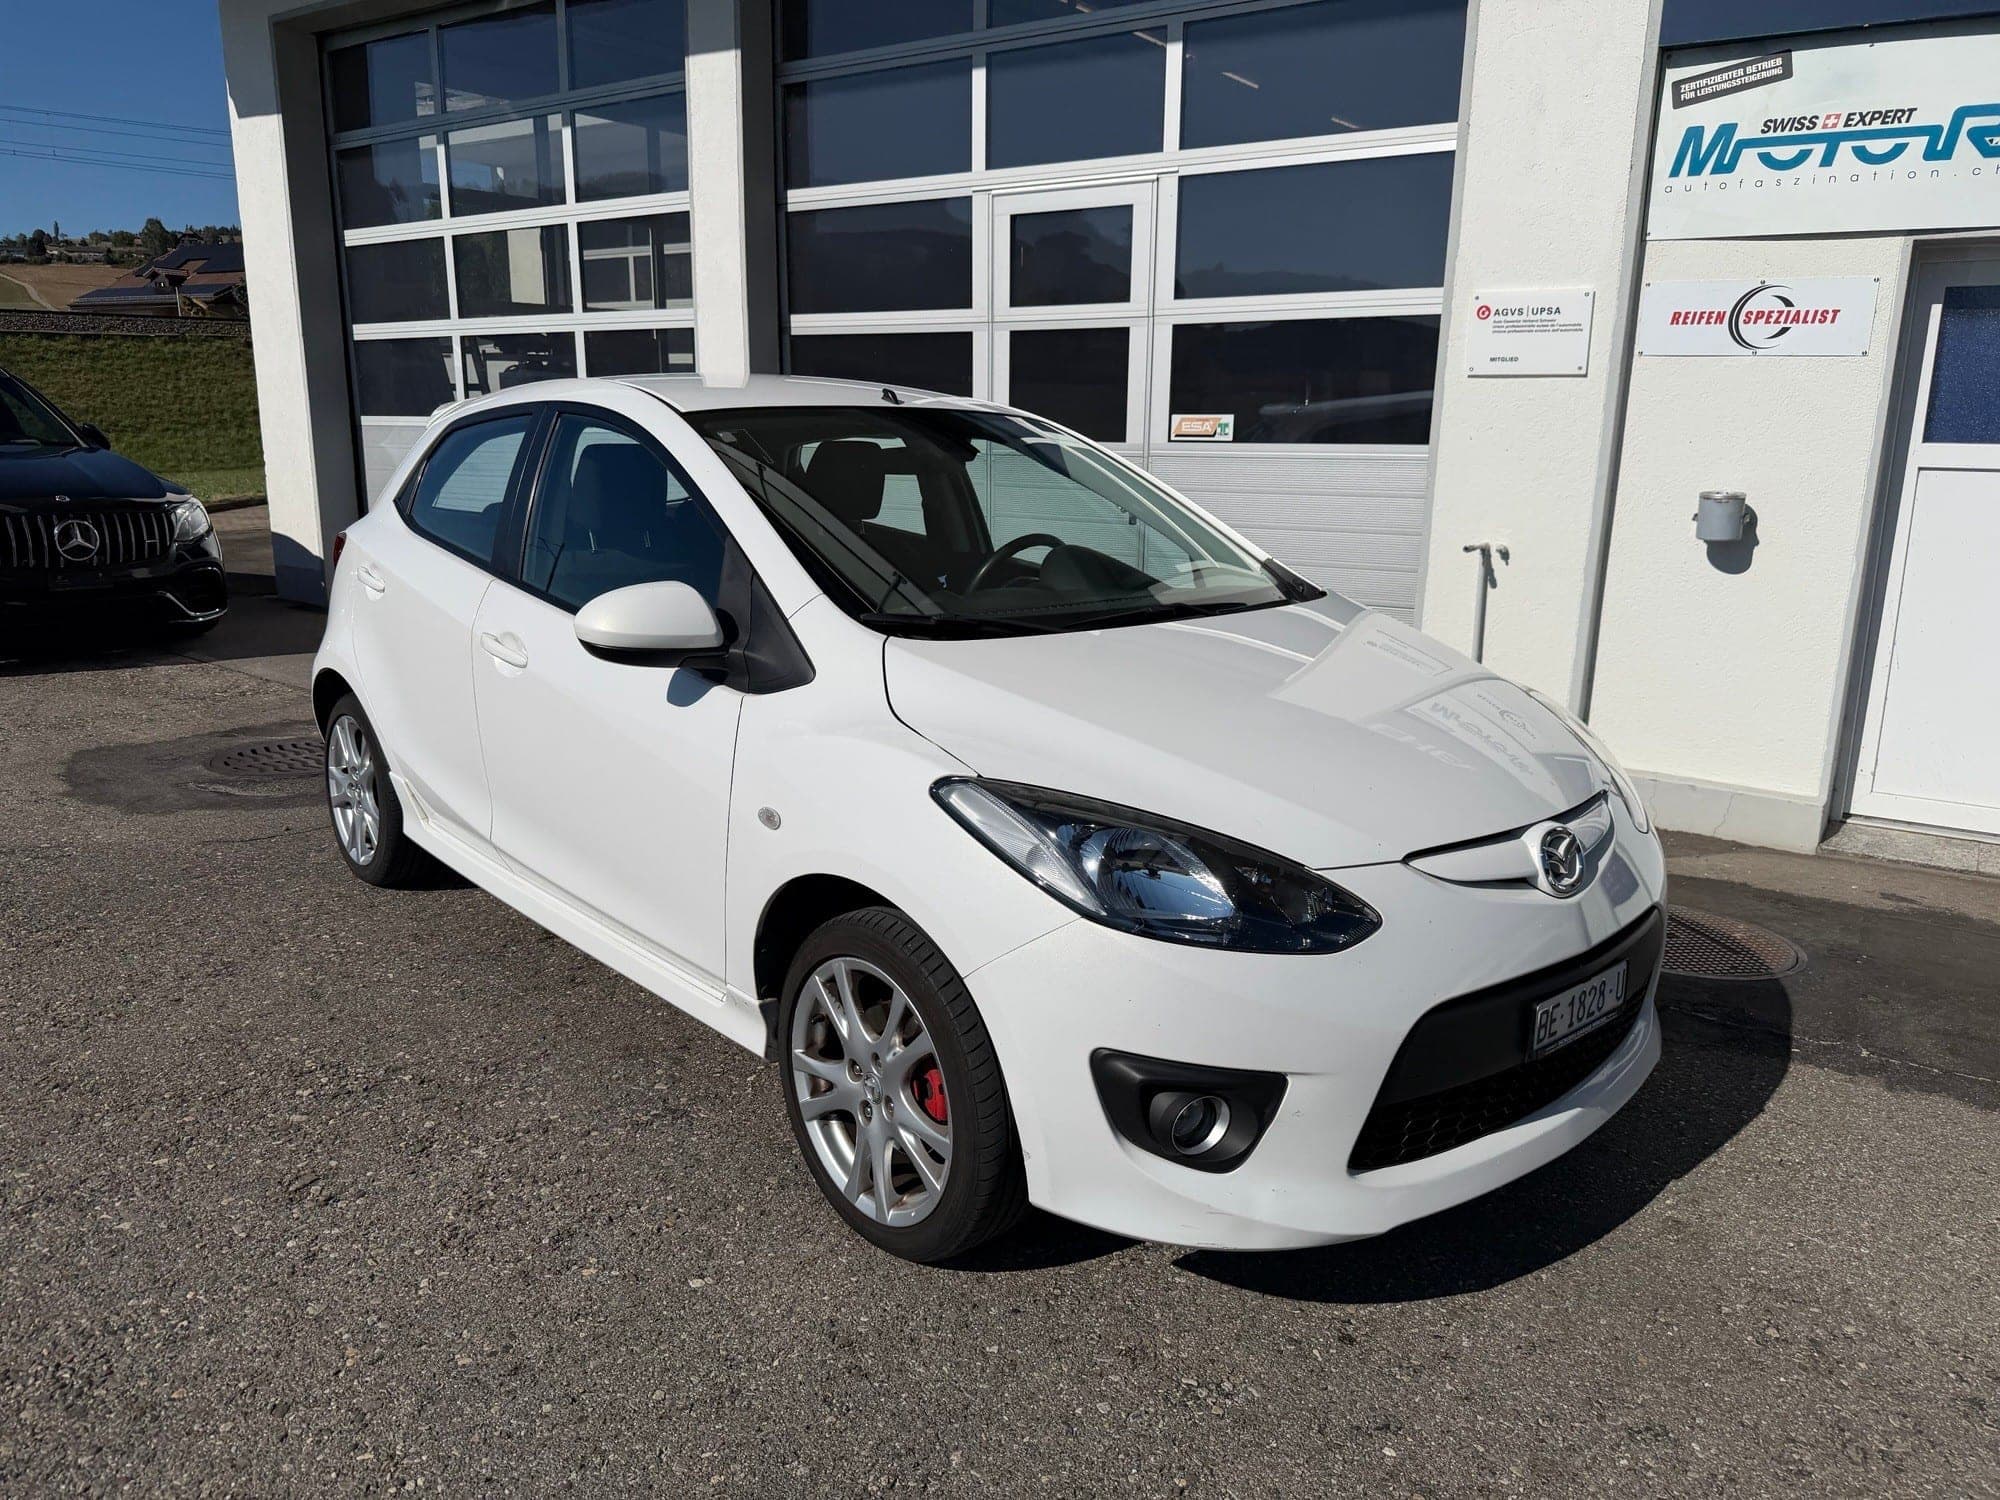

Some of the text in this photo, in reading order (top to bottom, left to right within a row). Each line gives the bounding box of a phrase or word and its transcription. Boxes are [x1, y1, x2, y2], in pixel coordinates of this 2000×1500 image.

[1680, 57, 1783, 93] ZERTIFIZIERTER BETRIEB
[1680, 67, 1783, 102] FÜR LEISTUNGSSTEIGERUNG
[1760, 107, 1918, 134] SWISS EXPERT
[1493, 306, 1561, 317] AGVS UPSA
[1669, 309, 1841, 326] REIFEN SPEZIALIST
